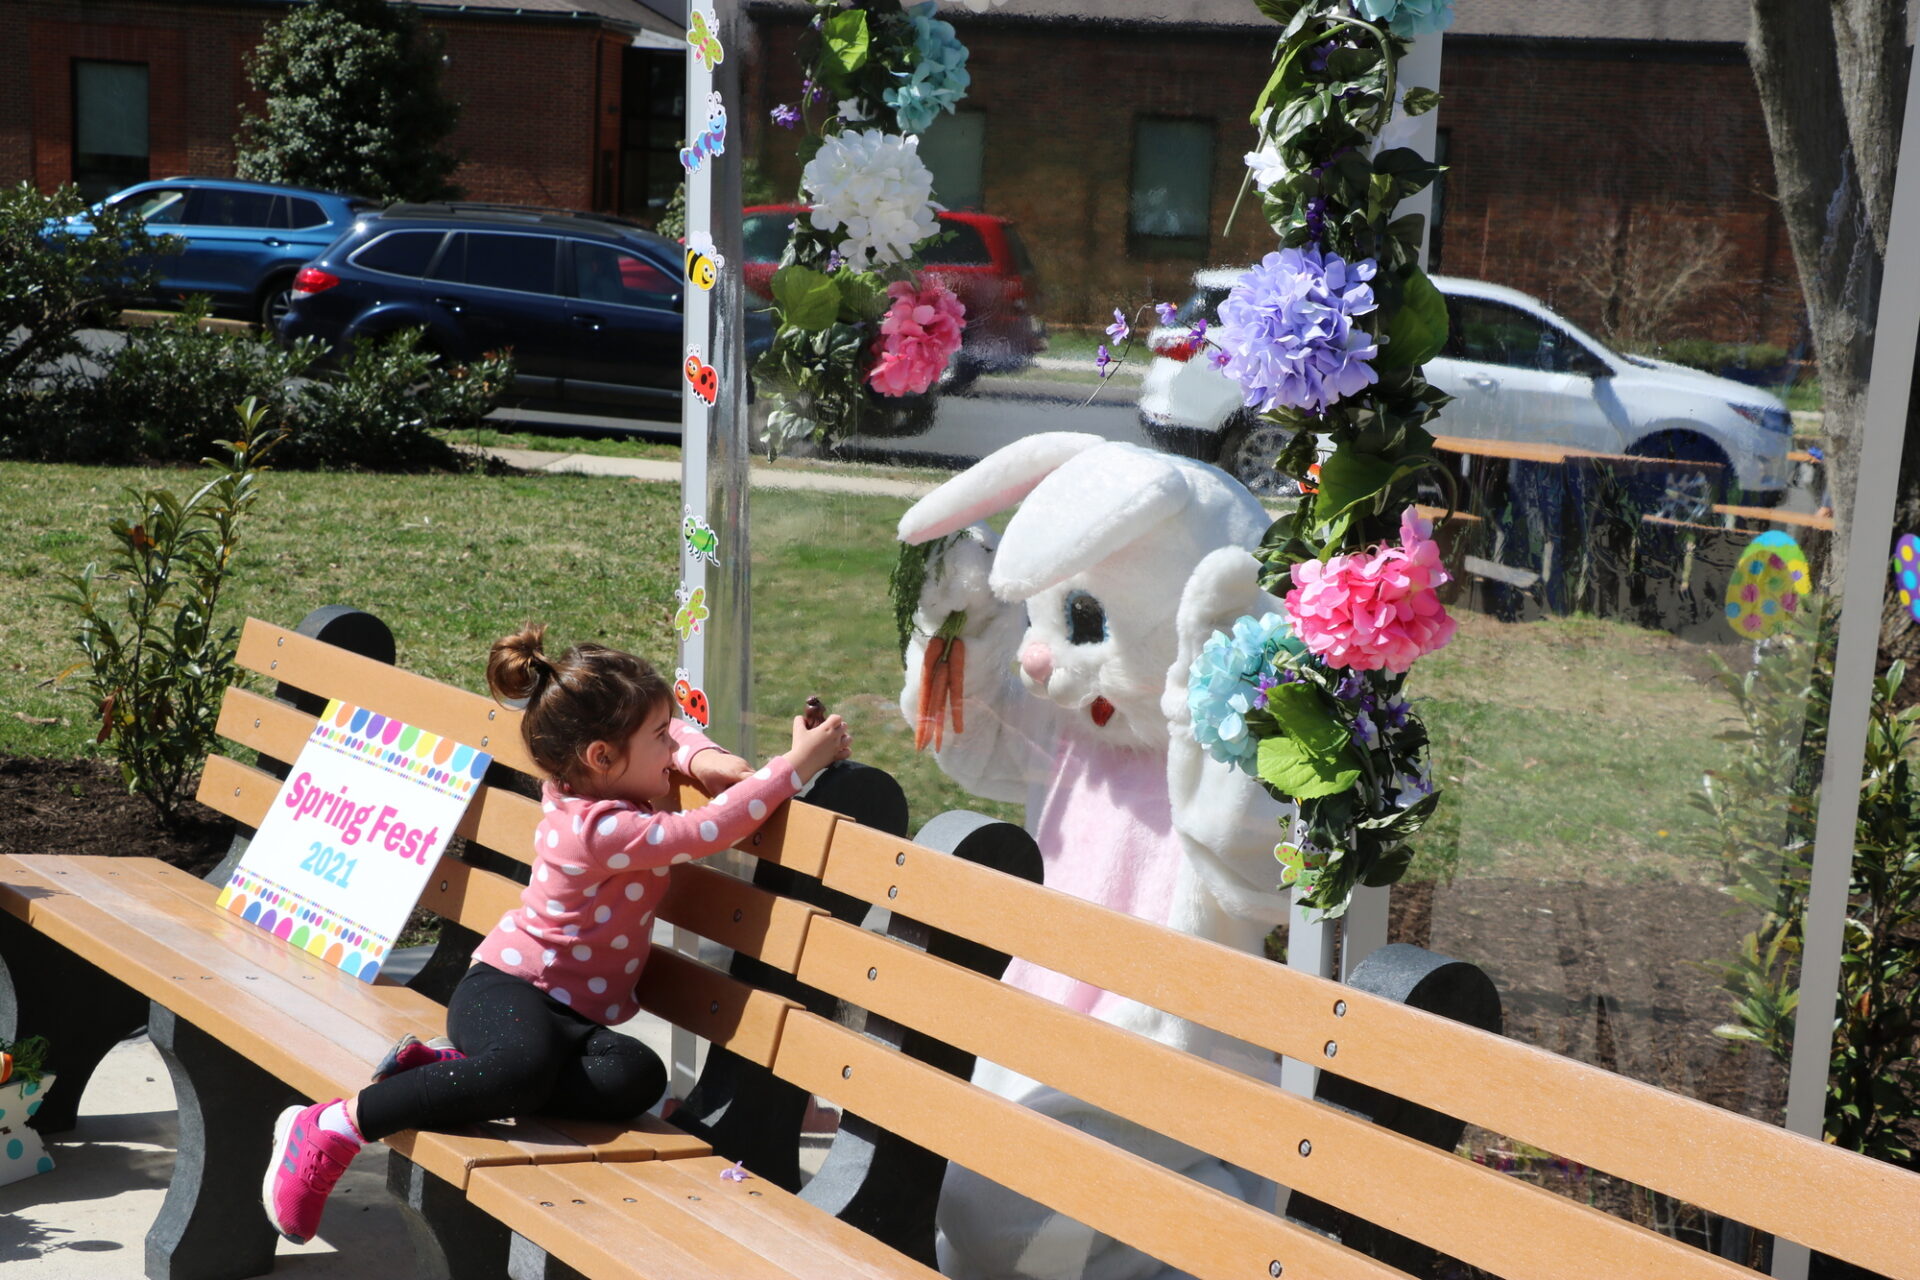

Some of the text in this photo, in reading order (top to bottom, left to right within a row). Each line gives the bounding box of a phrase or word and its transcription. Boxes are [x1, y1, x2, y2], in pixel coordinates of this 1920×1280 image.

[285, 772, 439, 866] Spring Fest
[299, 841, 358, 889] 2021
